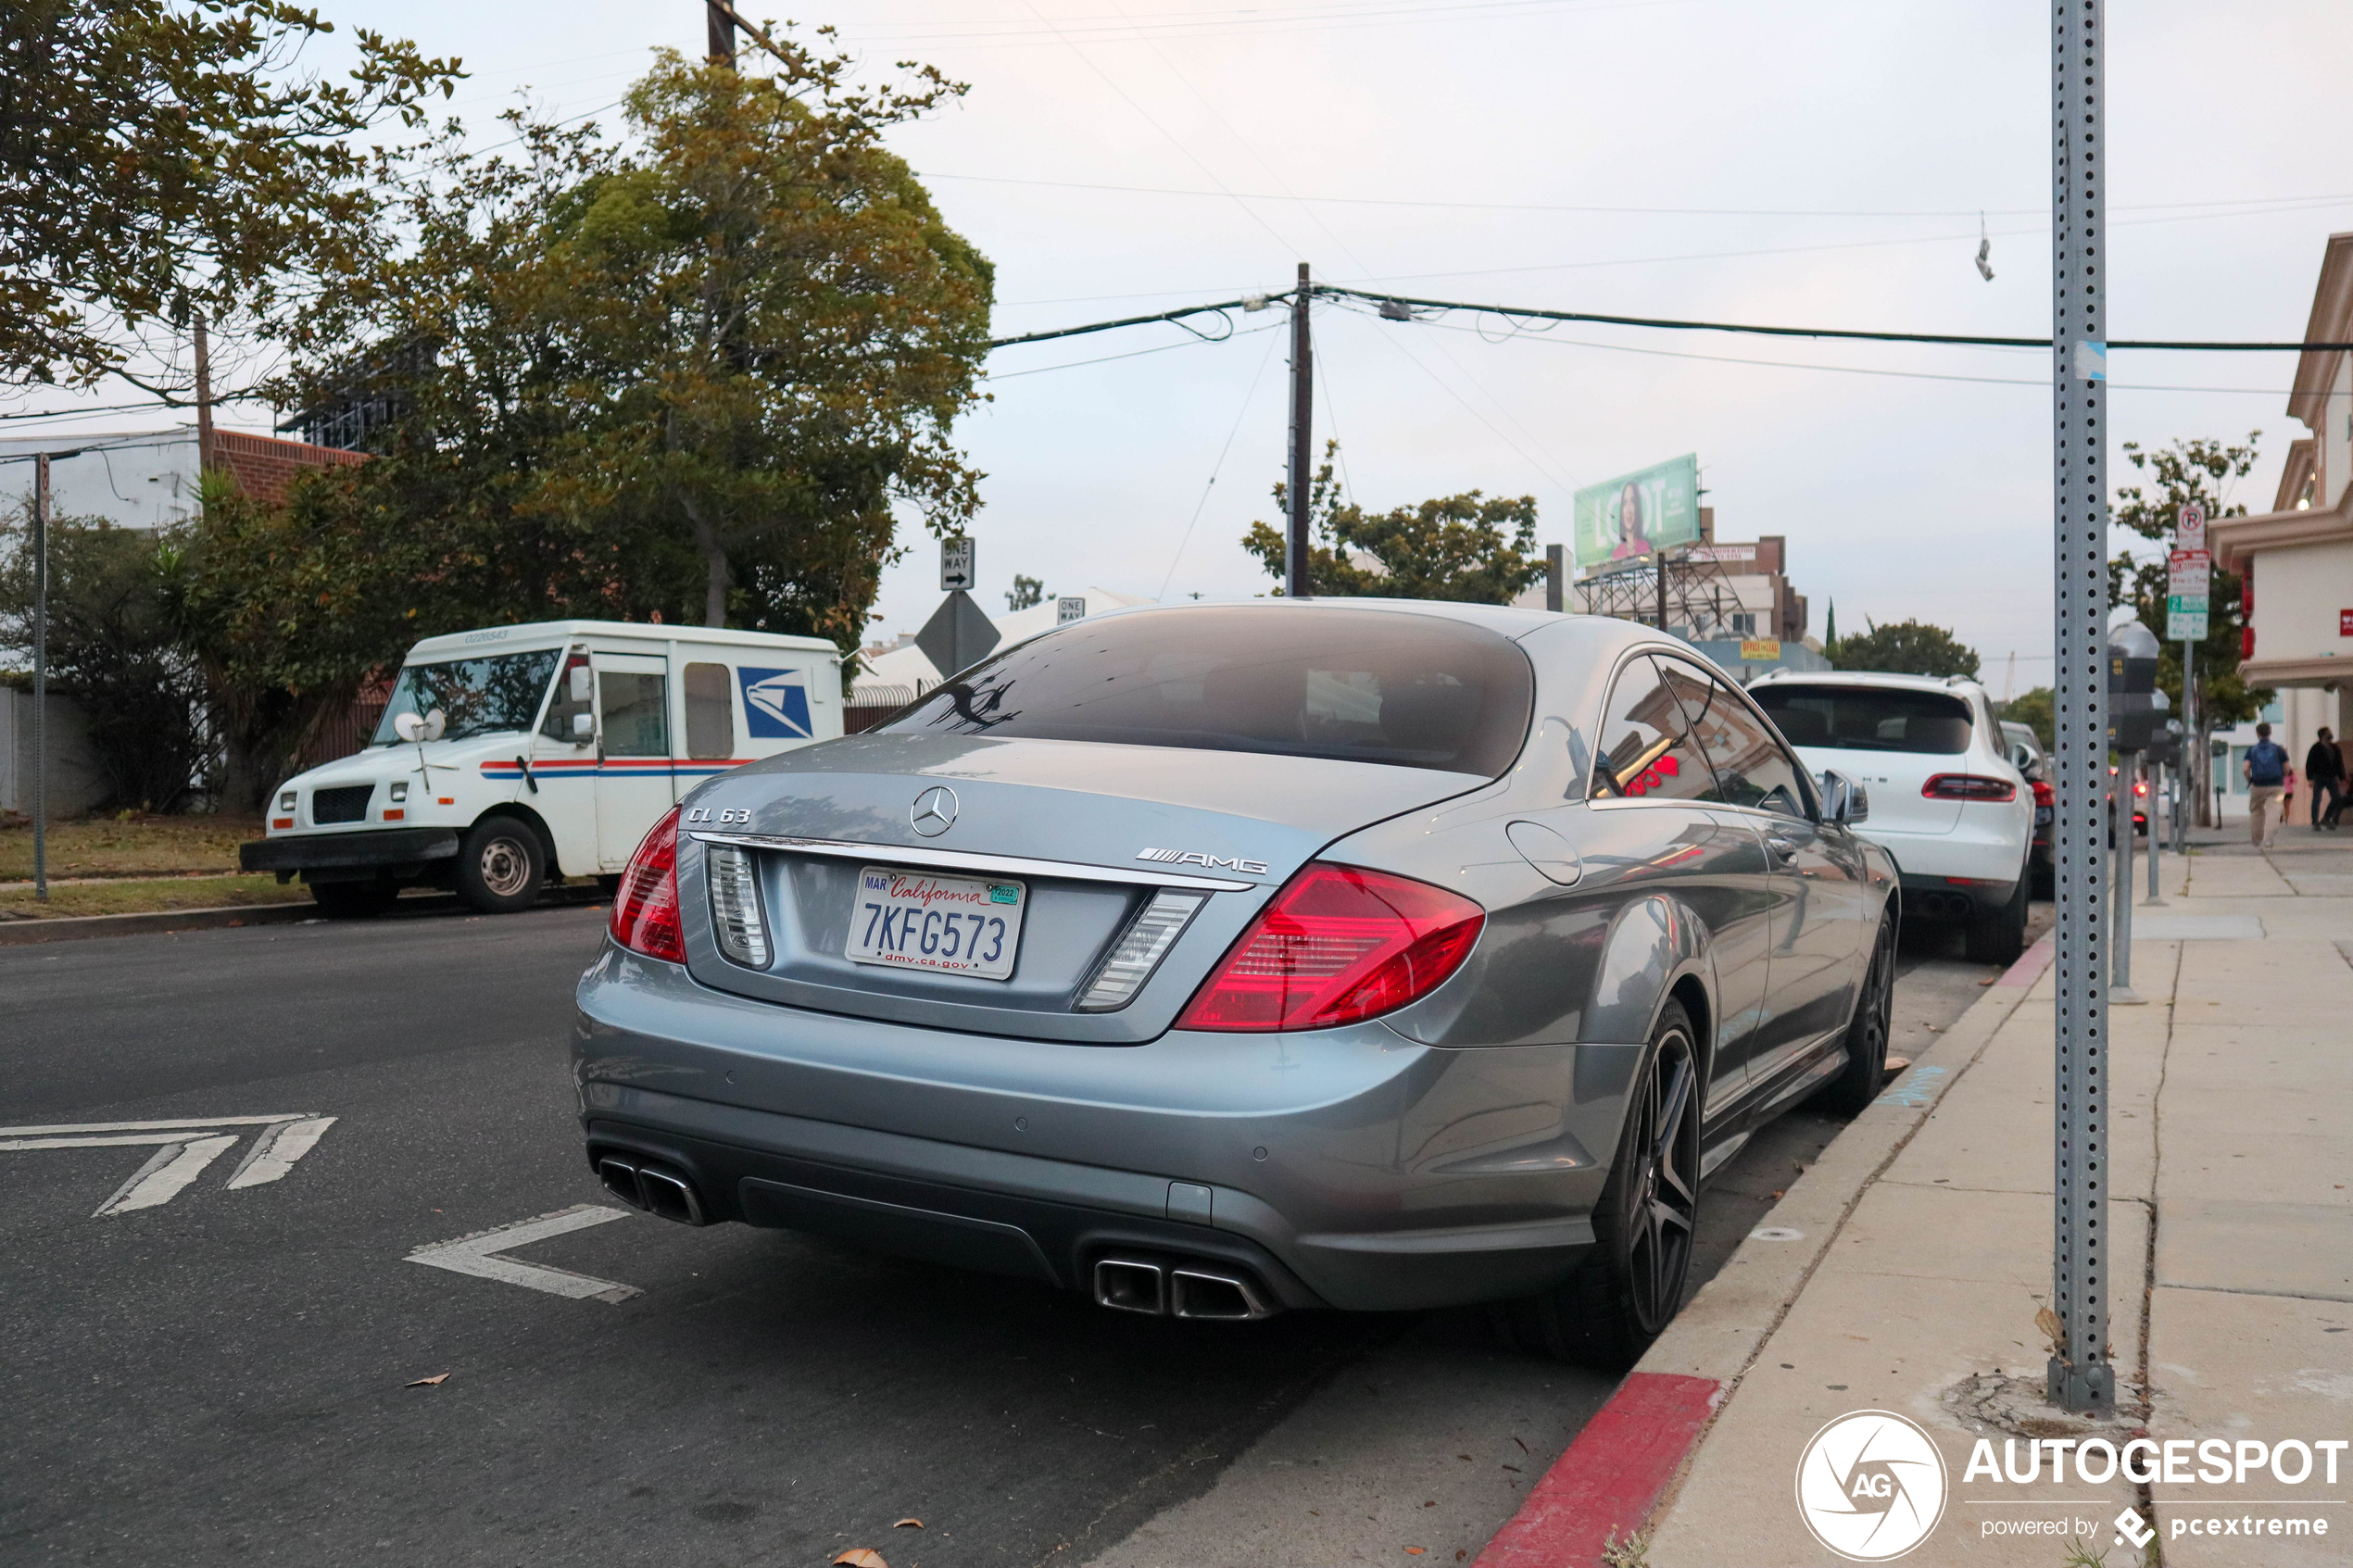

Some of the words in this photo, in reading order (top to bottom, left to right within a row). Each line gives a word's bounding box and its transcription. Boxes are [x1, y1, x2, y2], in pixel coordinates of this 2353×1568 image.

[944, 558, 968, 570] WAY
[1061, 602, 1080, 610] ONE
[688, 808, 712, 822] CL
[720, 809, 751, 823] 63
[1176, 851, 1268, 875] AMG
[864, 876, 887, 891] MAR
[890, 876, 991, 908] California
[863, 903, 1006, 962] 7KFG573
[885, 953, 969, 970] dmv.ca.gov
